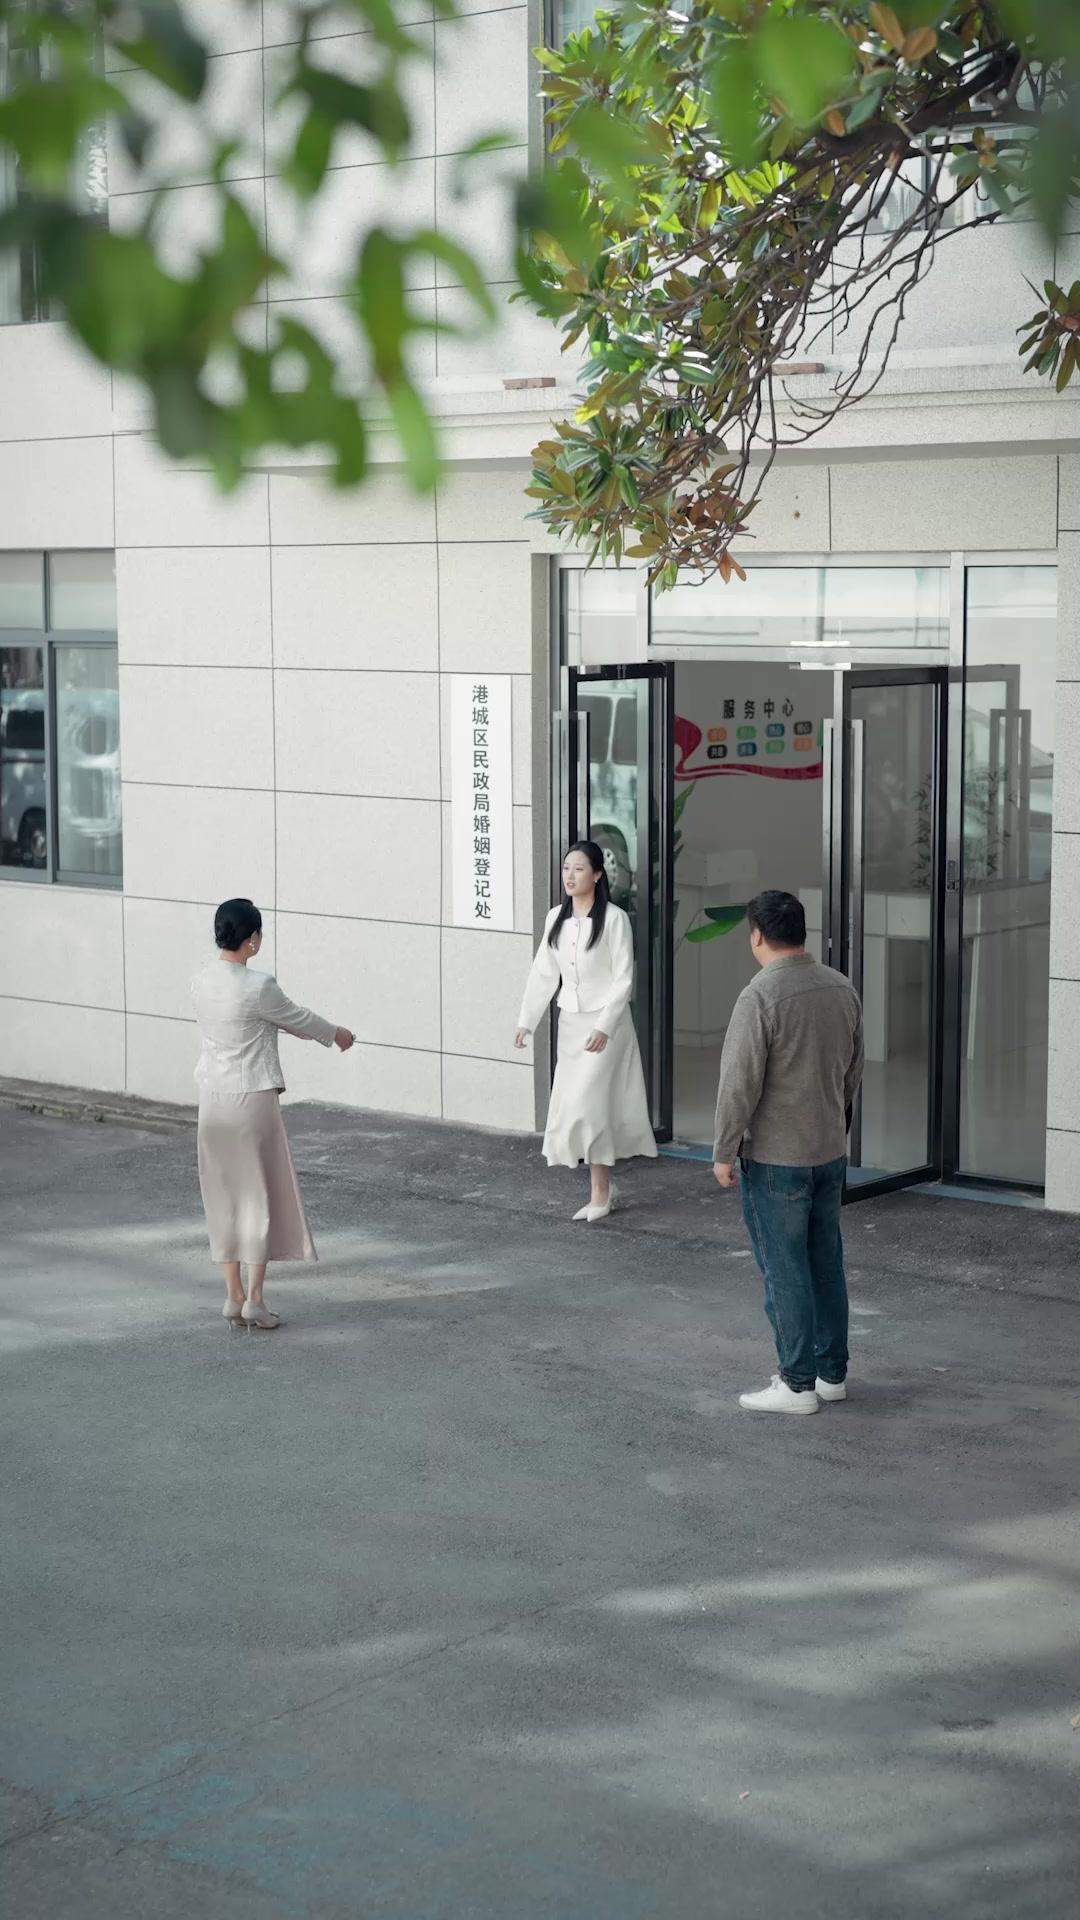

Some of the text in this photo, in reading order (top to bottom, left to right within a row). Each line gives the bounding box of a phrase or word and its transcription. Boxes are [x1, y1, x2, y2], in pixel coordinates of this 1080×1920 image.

[722, 698, 794, 719] 服务中心
[472, 684, 491, 919] 港城区民政局婚姻登记处
